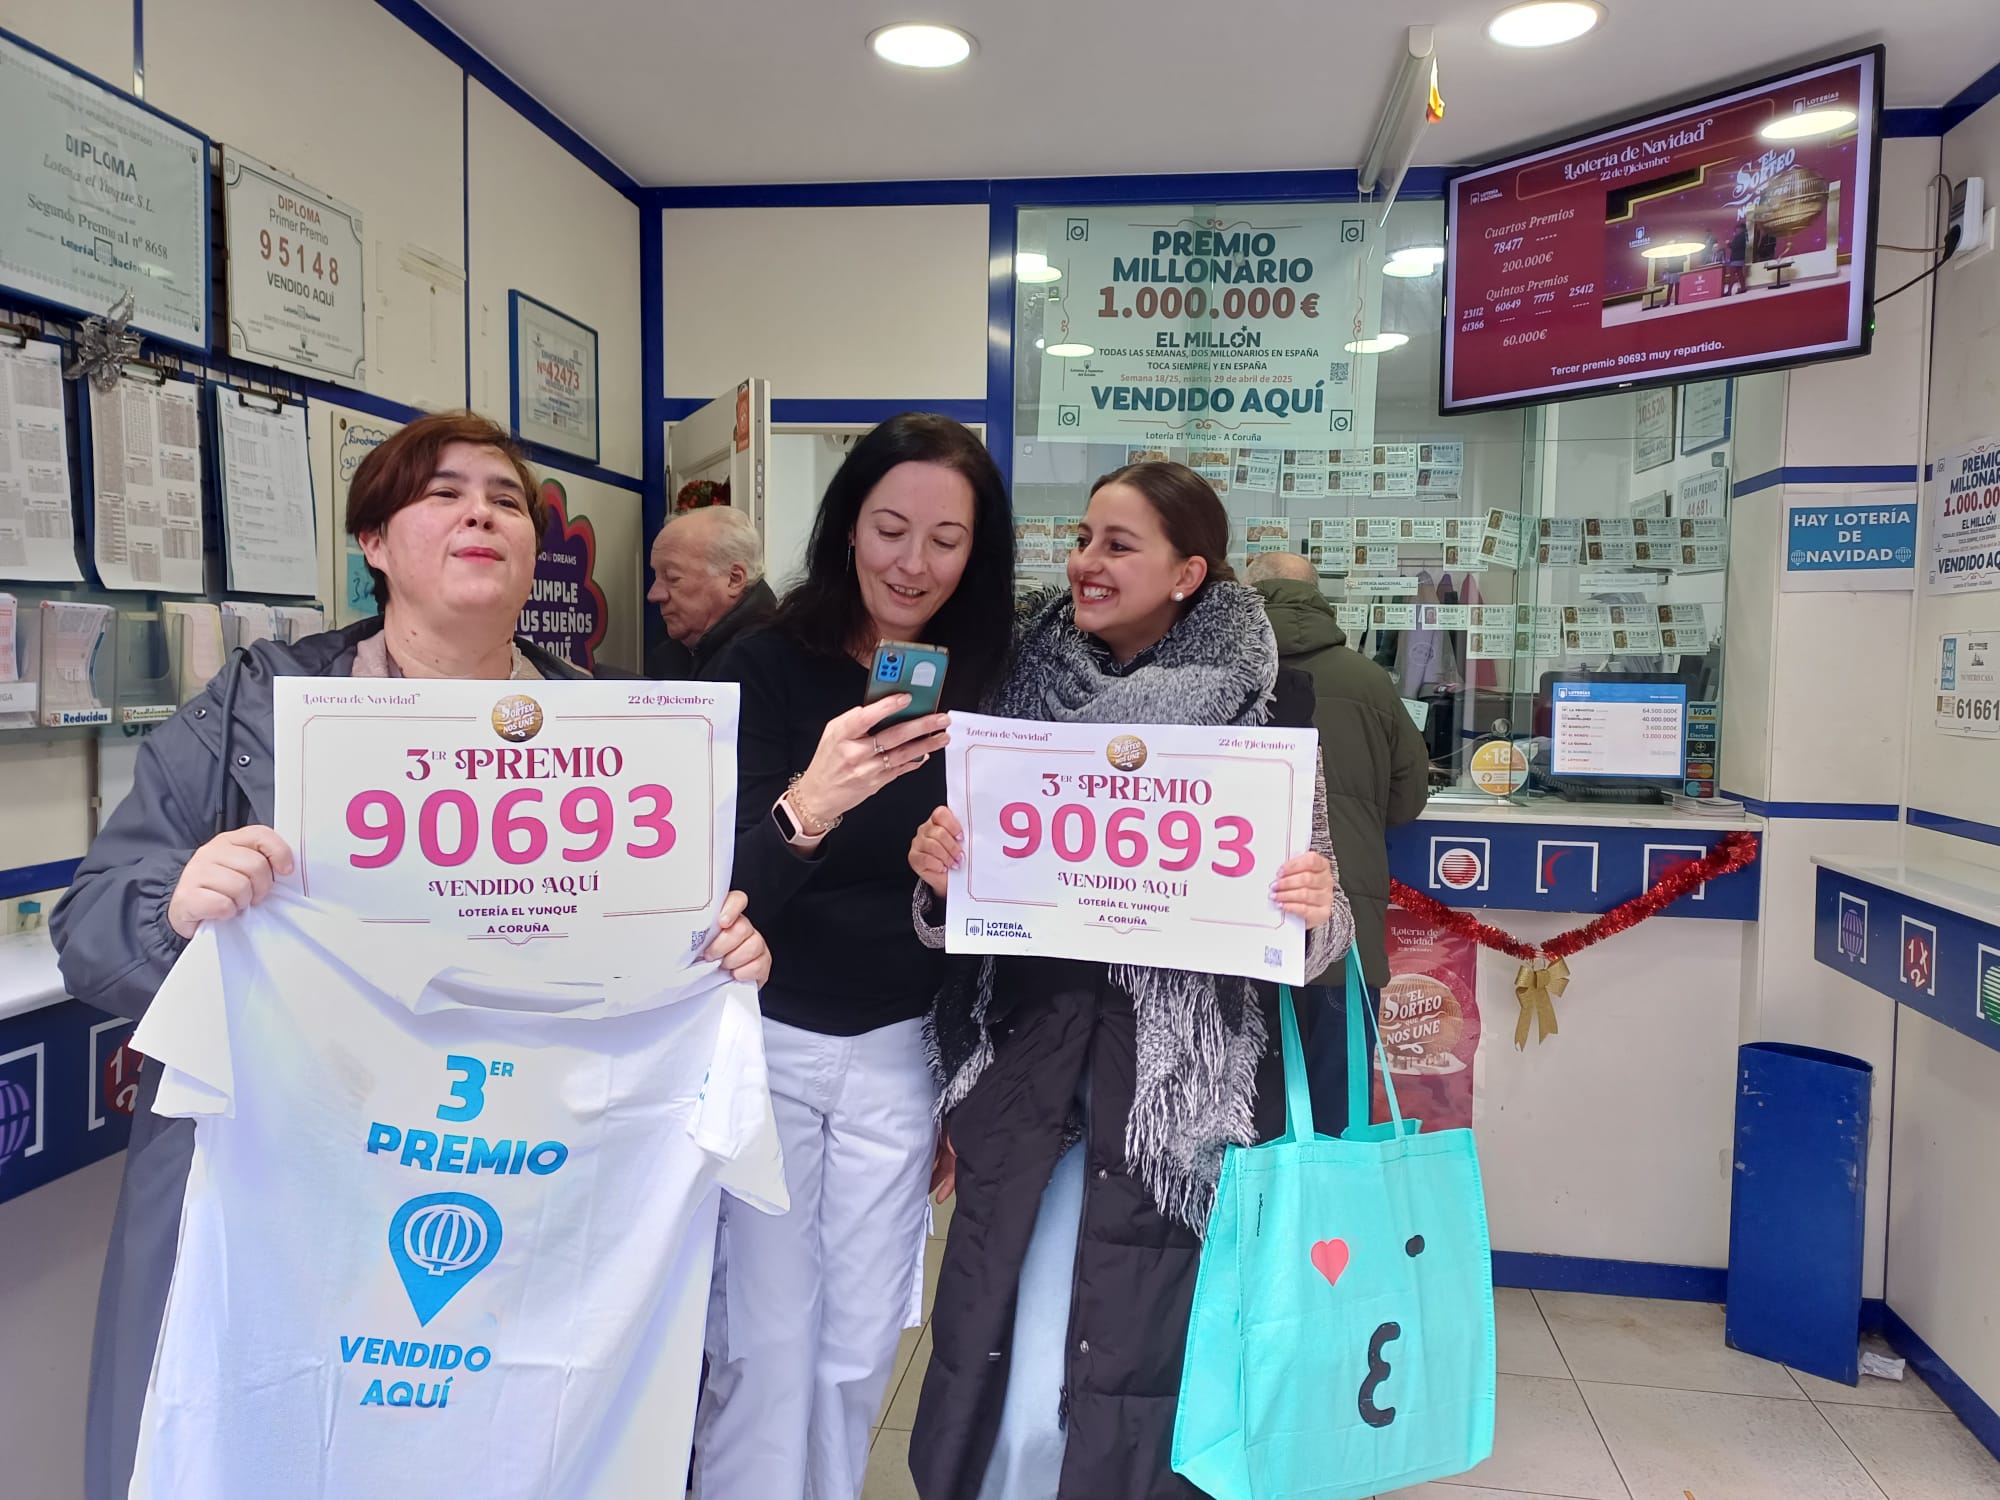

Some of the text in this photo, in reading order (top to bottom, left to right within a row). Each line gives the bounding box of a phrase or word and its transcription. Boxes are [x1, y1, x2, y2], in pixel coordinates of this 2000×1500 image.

[66, 134, 137, 181] DIPLOMA
[1564, 118, 1713, 181] Lotería de Navidad
[1600, 155, 1671, 182] 22 de Diciembre
[1732, 147, 1796, 199] SORTEO
[278, 194, 321, 225] DIPLOMA
[269, 208, 328, 246] Primer Premio
[1484, 208, 1575, 240] Cuartos Premios
[118, 230, 129, 244] al
[145, 240, 168, 259] 8658
[1152, 230, 1276, 257] PREMIO
[1493, 237, 1524, 255] 78477
[1112, 257, 1314, 284] MILLONARIO
[1502, 251, 1554, 273] 200.000€
[267, 270, 335, 307] VENDIDO AQUÍ
[1486, 274, 1569, 301] Quintos Premios
[1463, 283, 1595, 319] 23112 60649 77715 25412
[1156, 325, 1261, 349] EL MILLÓN
[1462, 320, 1485, 332] 61366
[1503, 329, 1548, 347] 60.000€
[1099, 347, 1320, 359] TODAS LAS SEMANAS, DOS MILLONARIOS EN ESPAÑA
[1551, 340, 1726, 376] Tercer premio 90693 muy repartido.
[1147, 361, 1170, 370] TOCA
[1212, 362, 1218, 370] Y
[1220, 362, 1233, 370] EN
[1234, 360, 1268, 371] ESPAÑA
[1120, 374, 1153, 384] Semana
[1154, 375, 1181, 384] 18/25,
[1213, 375, 1225, 383] 29
[1226, 374, 1236, 383] de
[1238, 374, 1258, 383] abril
[1259, 374, 1271, 383] de
[1272, 375, 1293, 384] 2025
[1091, 379, 1325, 418] VENDIDO AQUÍ
[1146, 430, 1262, 442] Lotería El Yunque A Coruña
[1794, 508, 1911, 527] HAY LOTERÍA
[1962, 519, 1969, 530] EL
[1838, 529, 1862, 543] DE
[552, 553, 577, 565] DREAMS
[1806, 548, 1893, 564] NAVIDAD
[1938, 553, 1985, 574] VENDIDO
[528, 579, 578, 604] UMPLE
[515, 606, 592, 634] US SUEÑOS
[350, 694, 366, 705] de
[367, 692, 422, 706] Navidad
[628, 694, 715, 706] 22 de Diciembre
[63, 712, 108, 723] Reducidas
[1693, 708, 1712, 716] VISA
[503, 716, 535, 734] NOS UNE
[999, 729, 1010, 739] de
[1011, 731, 1053, 743] Navidad
[1218, 738, 1296, 751] 22 de Diciembre
[455, 746, 624, 780] PREMIO
[1078, 773, 1213, 806] PREMIO
[345, 783, 677, 869] 90693
[999, 802, 1256, 878] 90693
[428, 871, 599, 897] VENDIDO AQUÍ
[1057, 871, 1188, 898] VENDIDO AQUÍ
[458, 904, 578, 918] LOTERÍA EL YUNQUE
[1078, 896, 1171, 913] LOTERÍA EL YUNQUE
[487, 922, 550, 934] A CORUÑA
[987, 920, 1023, 931] LOTERÍA
[1099, 914, 1148, 926] A CORUÑA
[987, 929, 1033, 939] NACIONAL
[1397, 936, 1434, 946] Navidad
[1427, 928, 1439, 937] de
[1407, 989, 1424, 1001] EL
[1383, 994, 1442, 1022] SORTEO
[1386, 1020, 1441, 1045] NOS UNE
[367, 1122, 568, 1176] PREMIO
[340, 1335, 491, 1372] VENDIDO
[360, 1376, 453, 1409] AQUÍ
